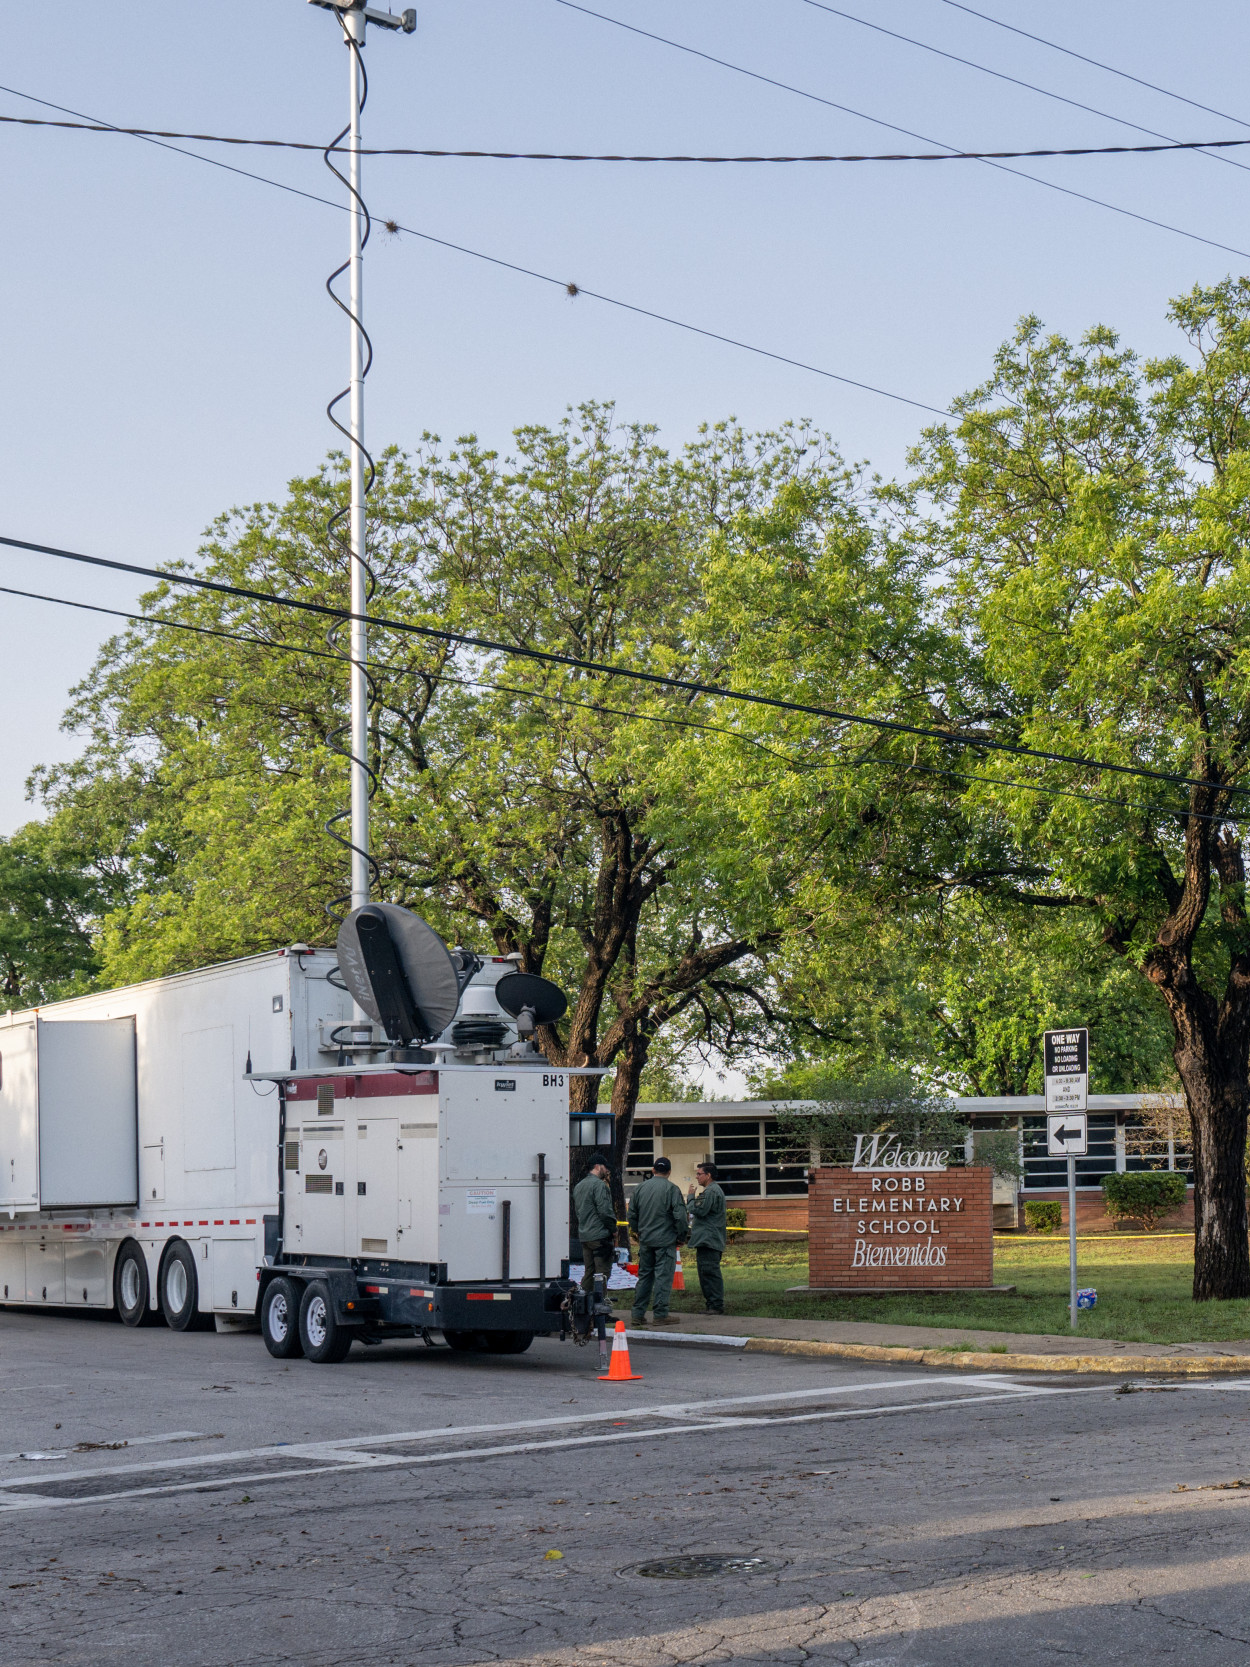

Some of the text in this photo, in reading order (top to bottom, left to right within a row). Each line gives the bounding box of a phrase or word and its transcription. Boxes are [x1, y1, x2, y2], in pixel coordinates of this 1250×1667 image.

[1052, 1033, 1080, 1045] ONE WAY
[1061, 1045, 1078, 1053] PARKING
[542, 1074, 564, 1087] BH3
[852, 1134, 949, 1168] Welcome
[872, 1178, 926, 1192] ROBB
[833, 1198, 963, 1212] ELEMENTARY
[857, 1220, 940, 1234] SCHOOL
[851, 1236, 948, 1267] Bienvenidos
